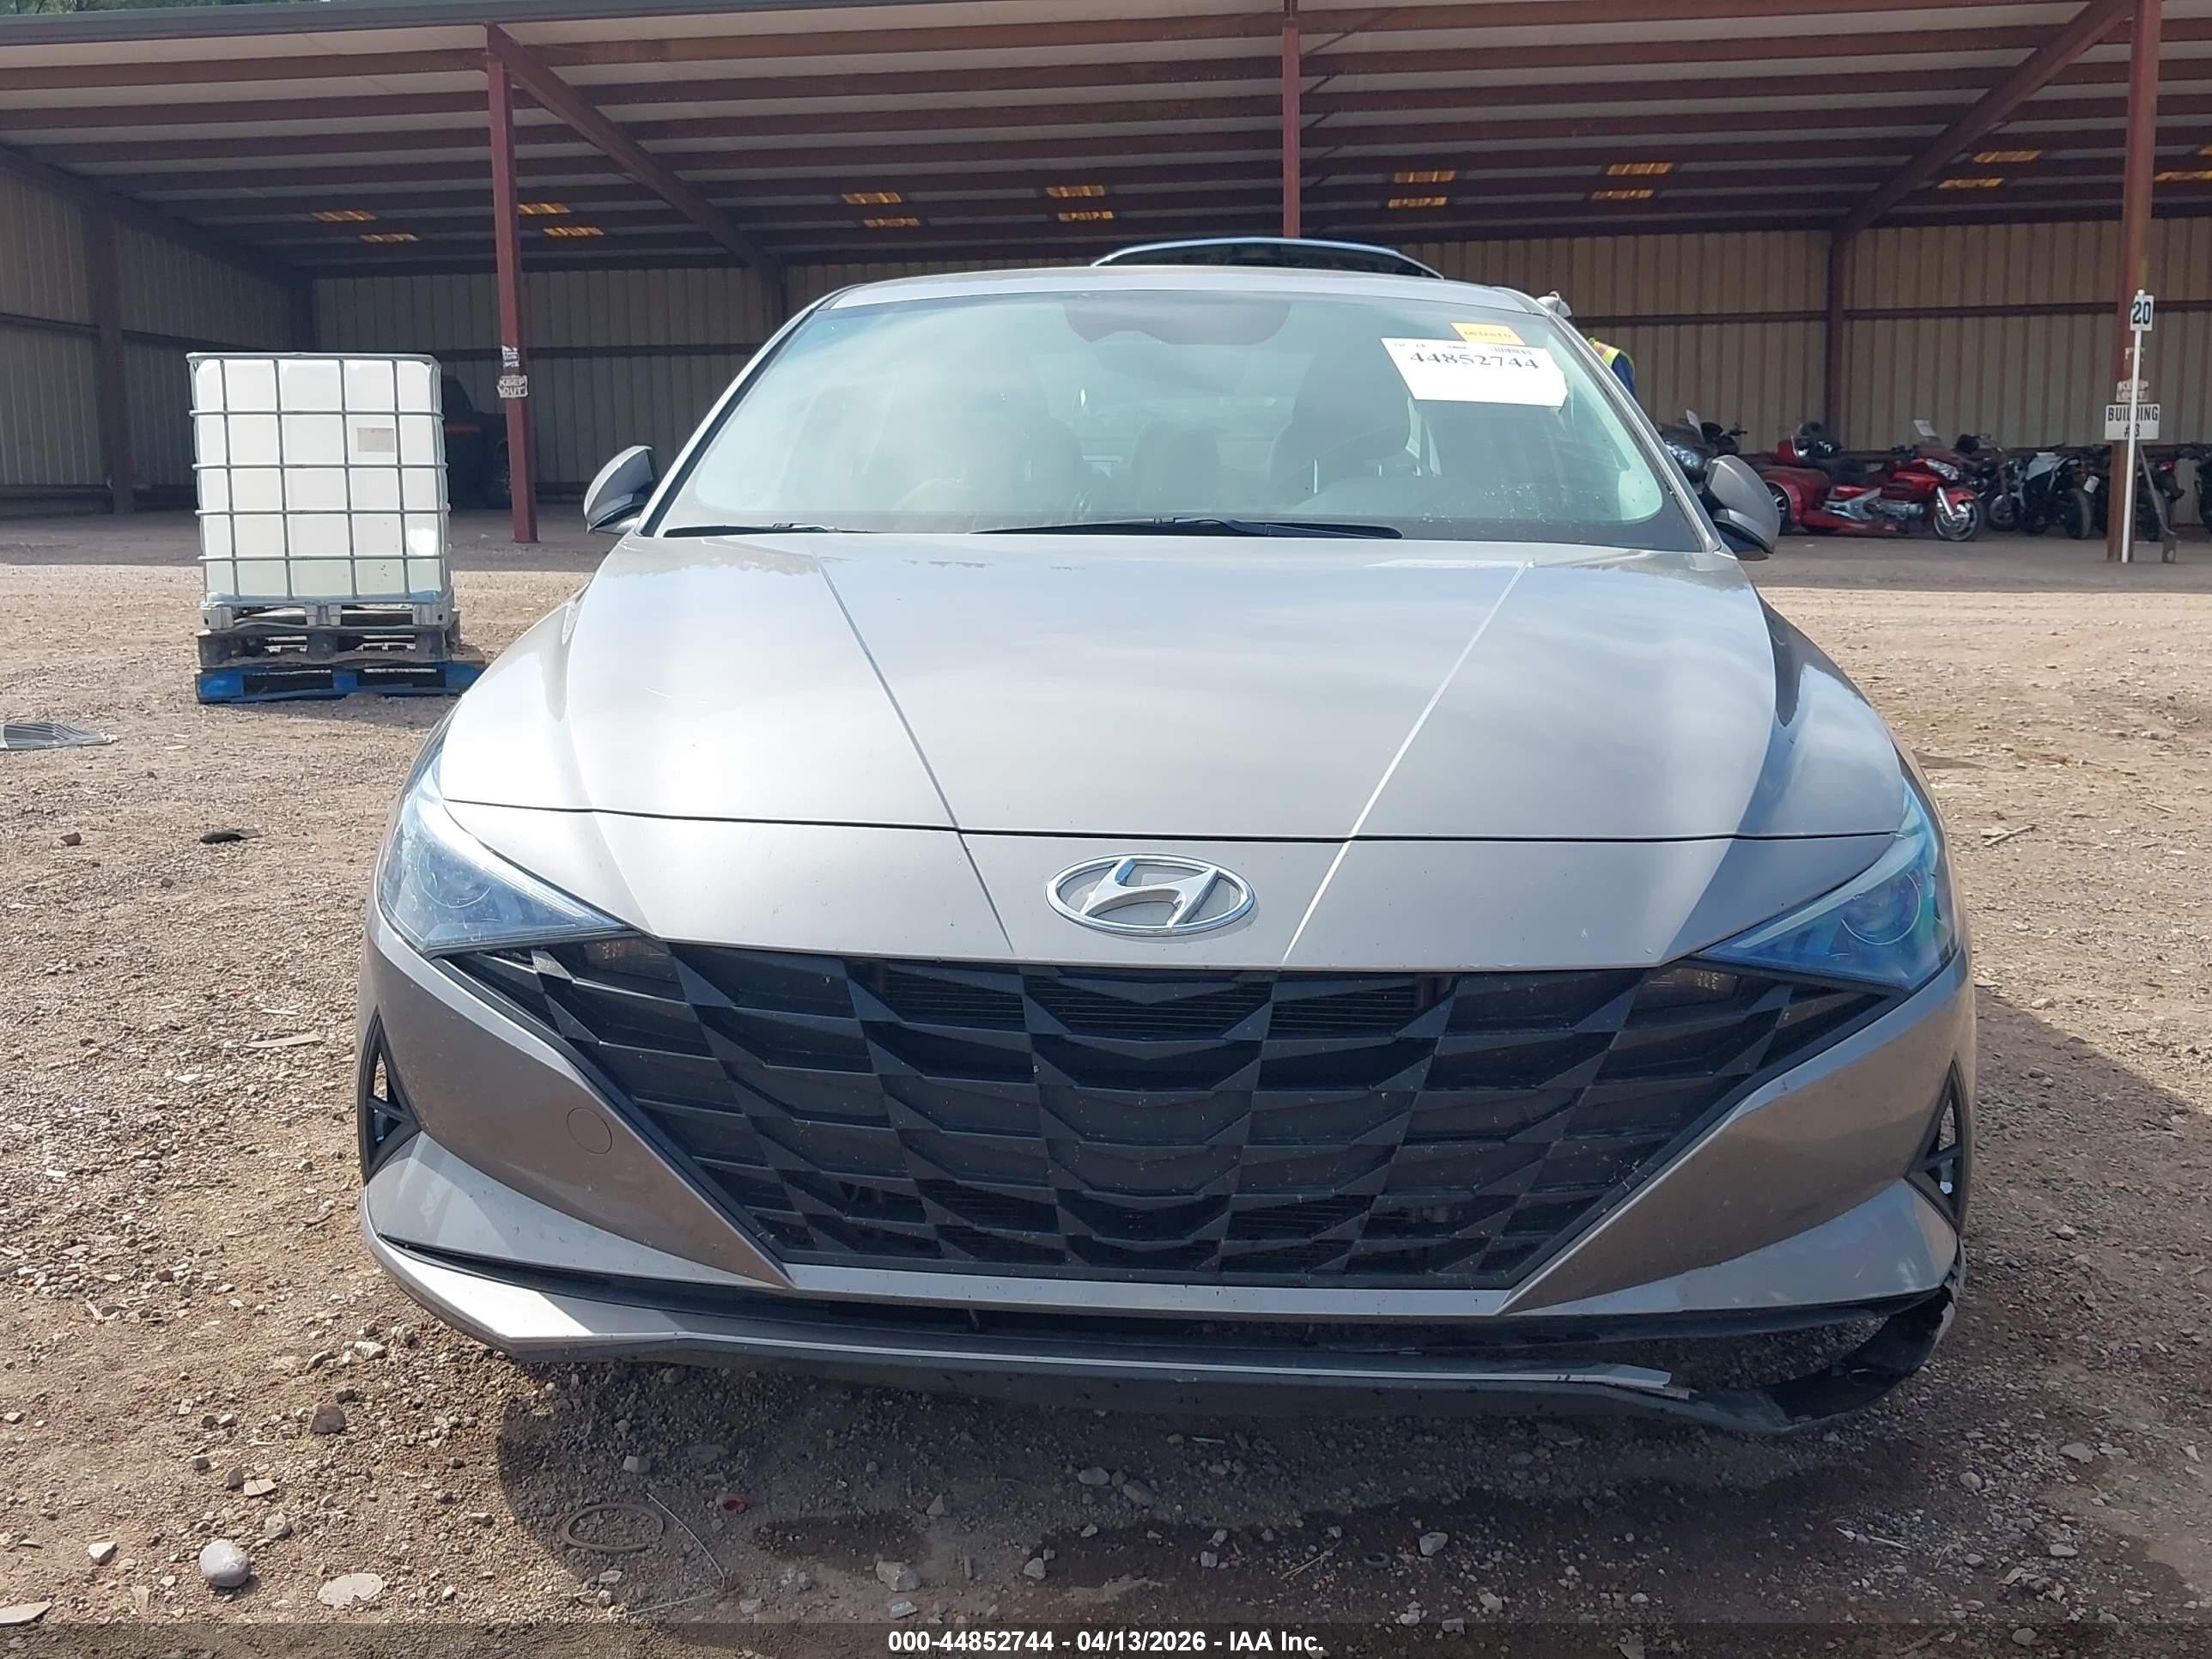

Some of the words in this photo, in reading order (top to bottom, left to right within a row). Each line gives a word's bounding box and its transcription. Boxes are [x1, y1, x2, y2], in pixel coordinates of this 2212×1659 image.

[2132, 301, 2151, 325] 20
[1410, 352, 1539, 369] 44852744
[2117, 380, 2148, 390] KEP
